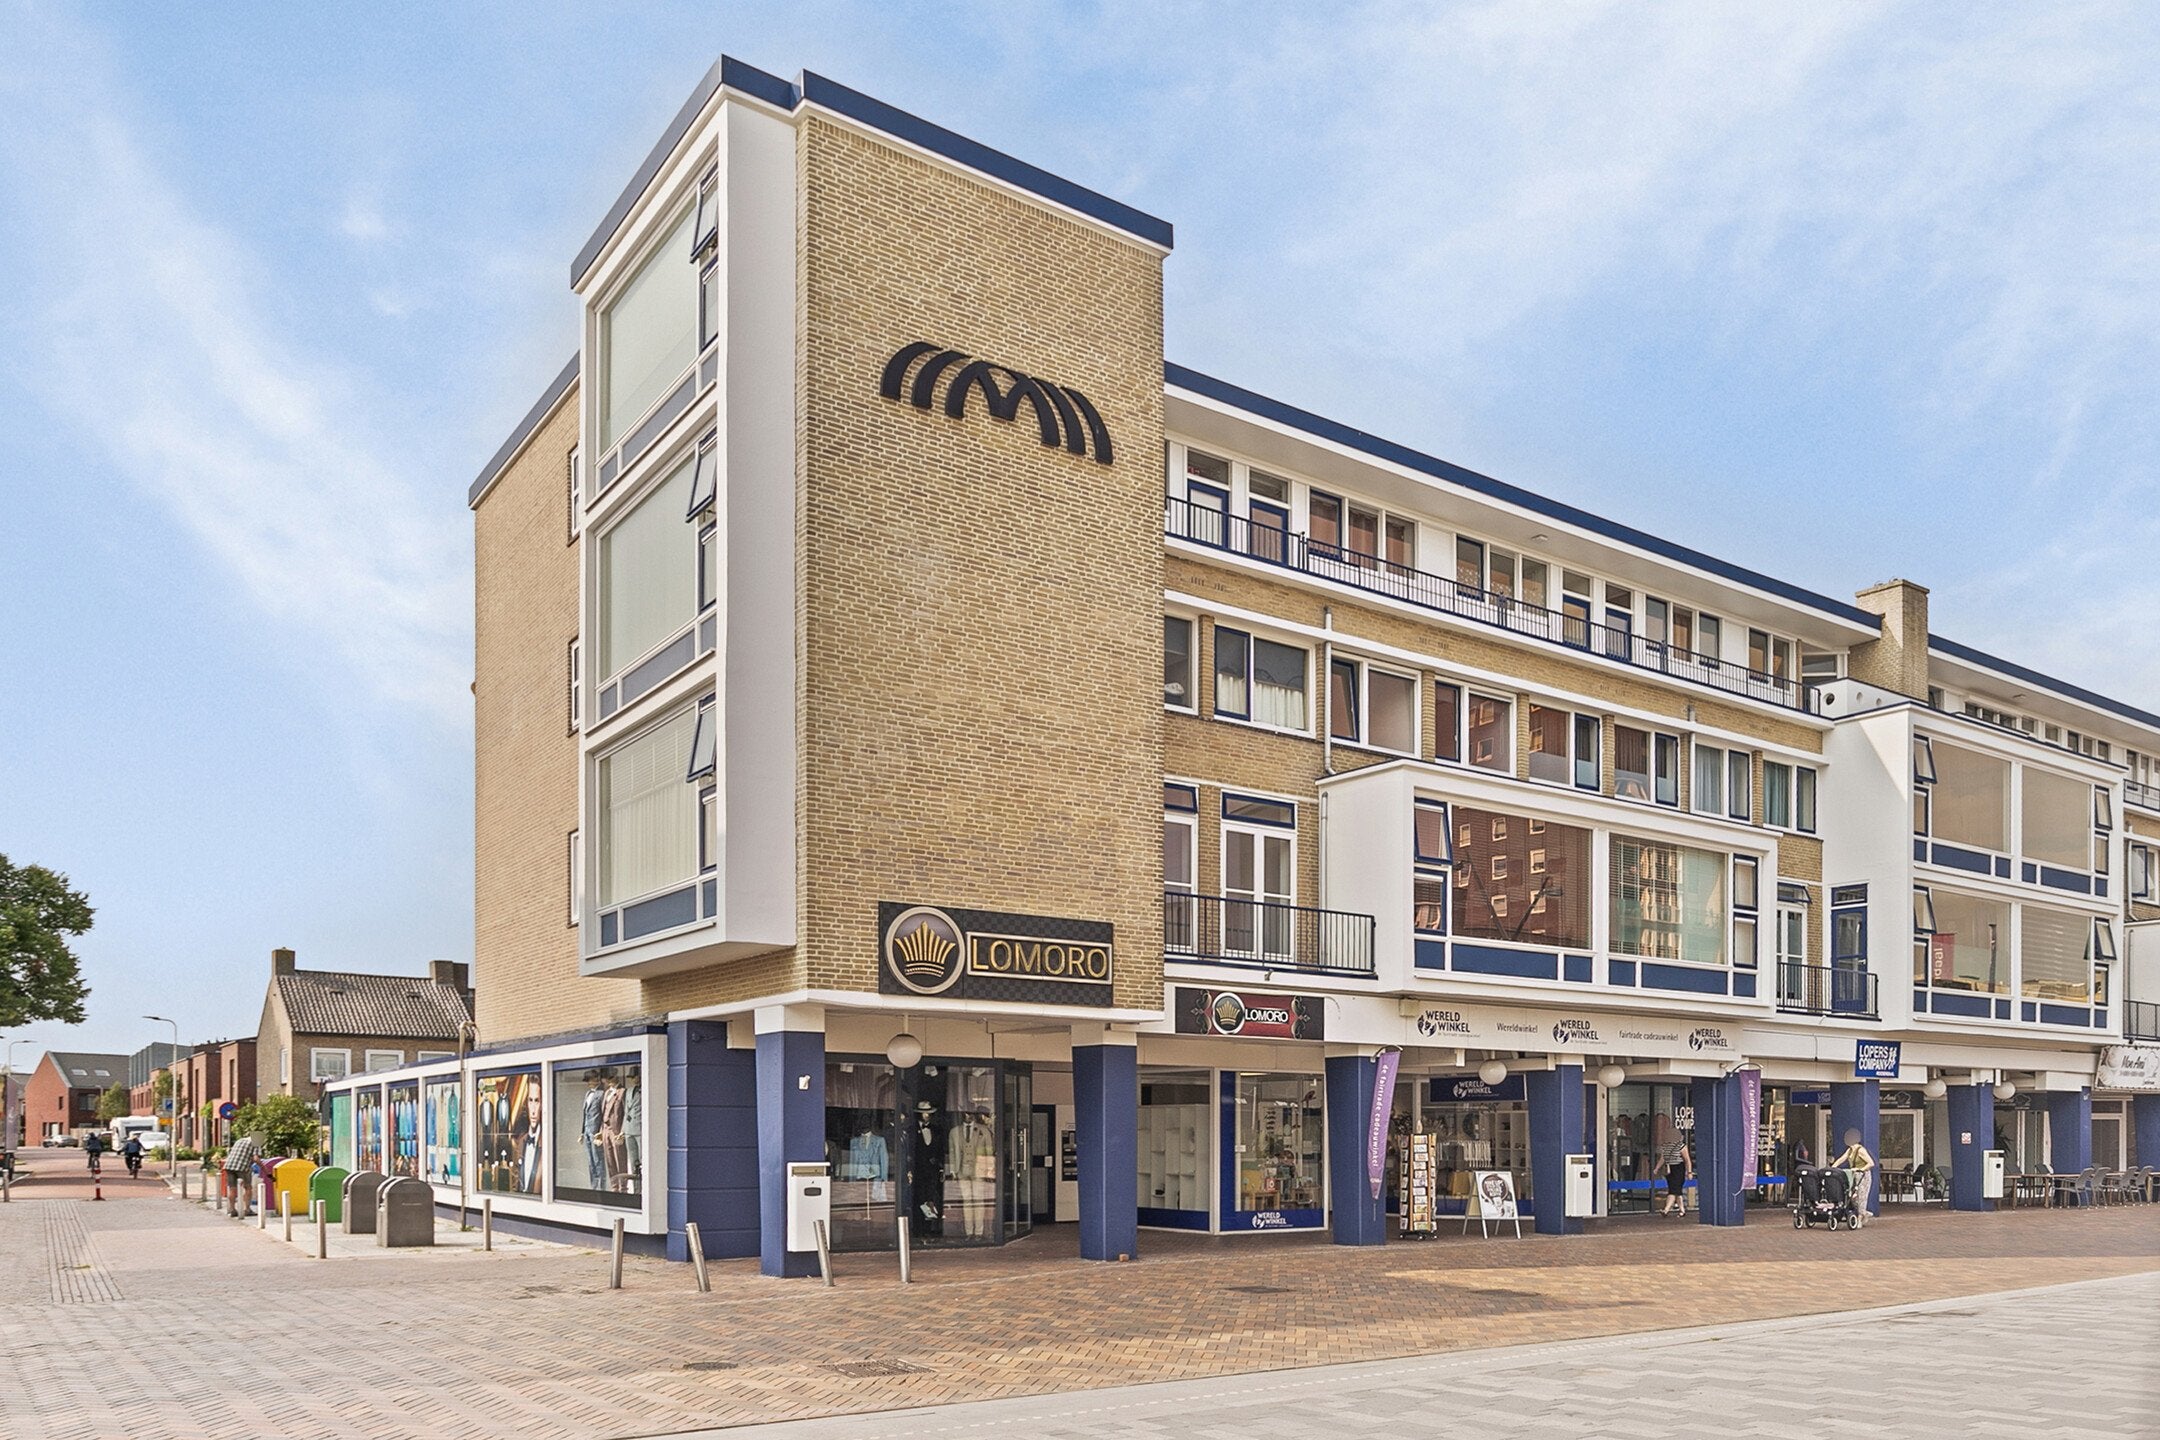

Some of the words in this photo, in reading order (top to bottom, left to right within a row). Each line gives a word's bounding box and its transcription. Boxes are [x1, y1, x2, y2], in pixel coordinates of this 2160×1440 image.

[973, 938, 1108, 978] LOMORO
[1245, 1009, 1289, 1022] LOMORO
[1425, 1010, 1461, 1022] WERELD
[1438, 1021, 1471, 1033] WINKEL
[1497, 1022, 1538, 1034] Wereldwinkel
[1560, 1019, 1591, 1030] WERELD
[1570, 1029, 1599, 1041] WINKEL
[1618, 1030, 1643, 1040] fairtrade
[1643, 1031, 1679, 1042] cadeauwinkel
[1695, 1028, 1722, 1038] WERELD
[1704, 1037, 1728, 1048] WINKEL
[1859, 1045, 1889, 1059] LOPERS
[1382, 1064, 1389, 1074] de
[1858, 1058, 1889, 1070] COMPANY
[1375, 1076, 1387, 1111] fairtrade
[1468, 1086, 1492, 1094] WINKEL
[1371, 1113, 1382, 1167] cadeauwinkel
